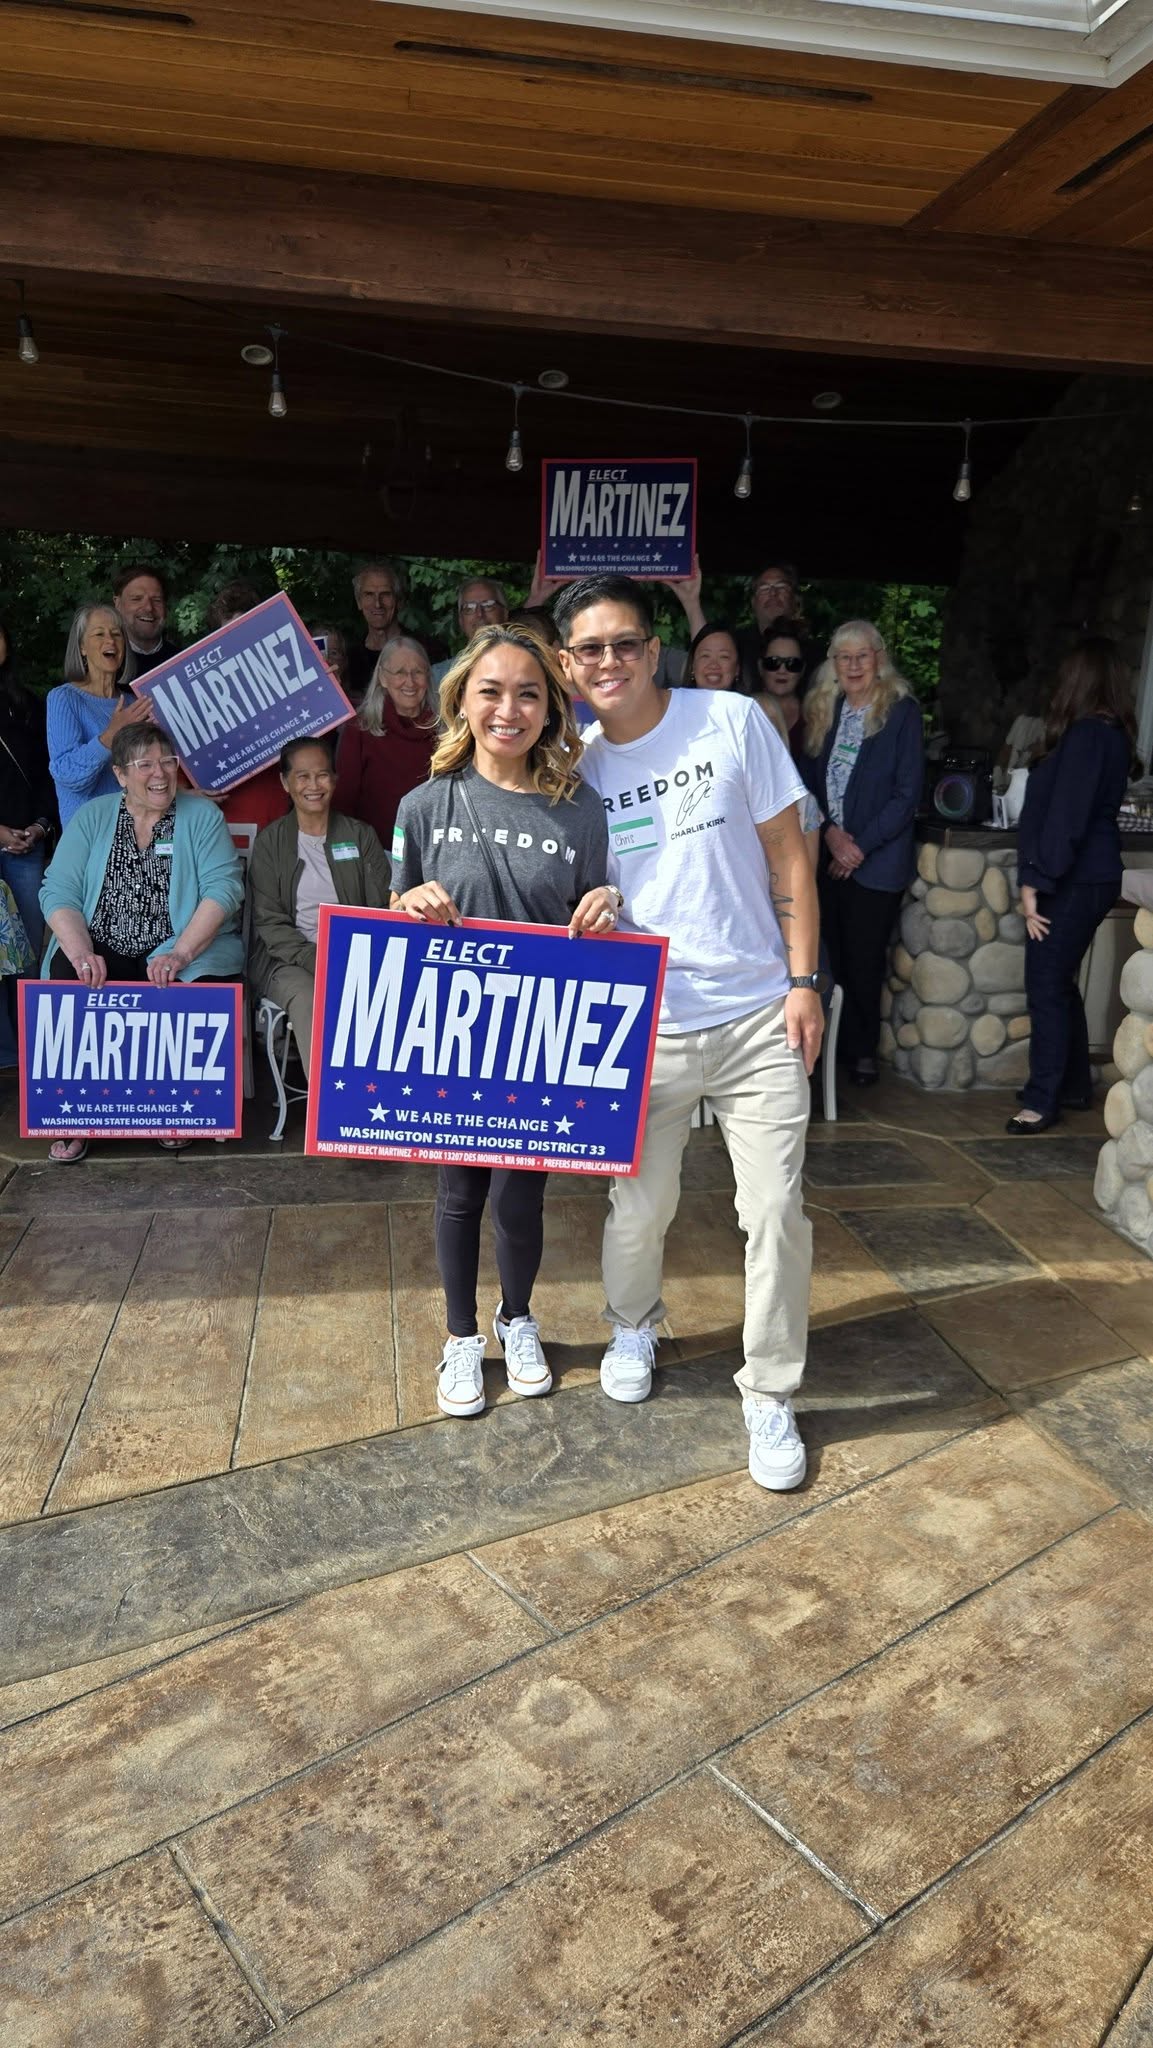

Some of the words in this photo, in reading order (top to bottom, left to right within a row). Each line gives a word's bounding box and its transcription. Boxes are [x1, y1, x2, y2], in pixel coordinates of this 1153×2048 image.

[588, 470, 627, 480] ELECT
[550, 470, 690, 536] MARTINEZ
[184, 646, 222, 678] ELECT
[151, 622, 318, 758] MARTINEZ
[210, 758, 254, 788] WASHINGTON
[253, 747, 273, 763] STATE
[295, 716, 325, 737] DISTRICT
[228, 752, 241, 764] WE
[240, 744, 256, 757] ARE
[255, 735, 270, 748] THE
[270, 717, 300, 739] CHANGE
[615, 834, 634, 846] Chris
[670, 824, 704, 840] CHARLIE
[706, 816, 726, 828] KIRK
[426, 938, 514, 965] ELECT
[87, 993, 142, 1007] ELECT
[330, 933, 647, 1090] MARTINEZ
[32, 994, 230, 1081] MARTINEZ
[77, 1104, 92, 1112] WE
[94, 1104, 114, 1112] ARE
[116, 1104, 135, 1112] THE
[137, 1104, 178, 1112] CHANGE
[396, 1110, 418, 1122] WE
[422, 1112, 451, 1125] ARE
[455, 1114, 483, 1127] THE
[487, 1117, 549, 1132] CHANGE
[340, 1126, 432, 1143] WASHINGTON
[435, 1134, 474, 1146] STATE
[477, 1136, 522, 1149] HOUSE
[528, 1140, 588, 1154] DISTRICT
[589, 1145, 606, 1156] 33
[317, 1142, 333, 1152] PAID
[334, 1144, 348, 1153] FOR
[349, 1145, 358, 1153] BY
[358, 1145, 378, 1155] ELECT
[379, 1147, 412, 1157] MARTINEZ
[418, 1150, 429, 1159] PO
[429, 1151, 442, 1160] BOX
[444, 1152, 463, 1161] 13207
[464, 1153, 476, 1161] DES
[504, 1156, 515, 1165] WA
[516, 1157, 535, 1166] 98198
[543, 1158, 570, 1168] PREFERS
[571, 1161, 610, 1172] REPUBLICAN
[611, 1163, 632, 1173] PARTY
